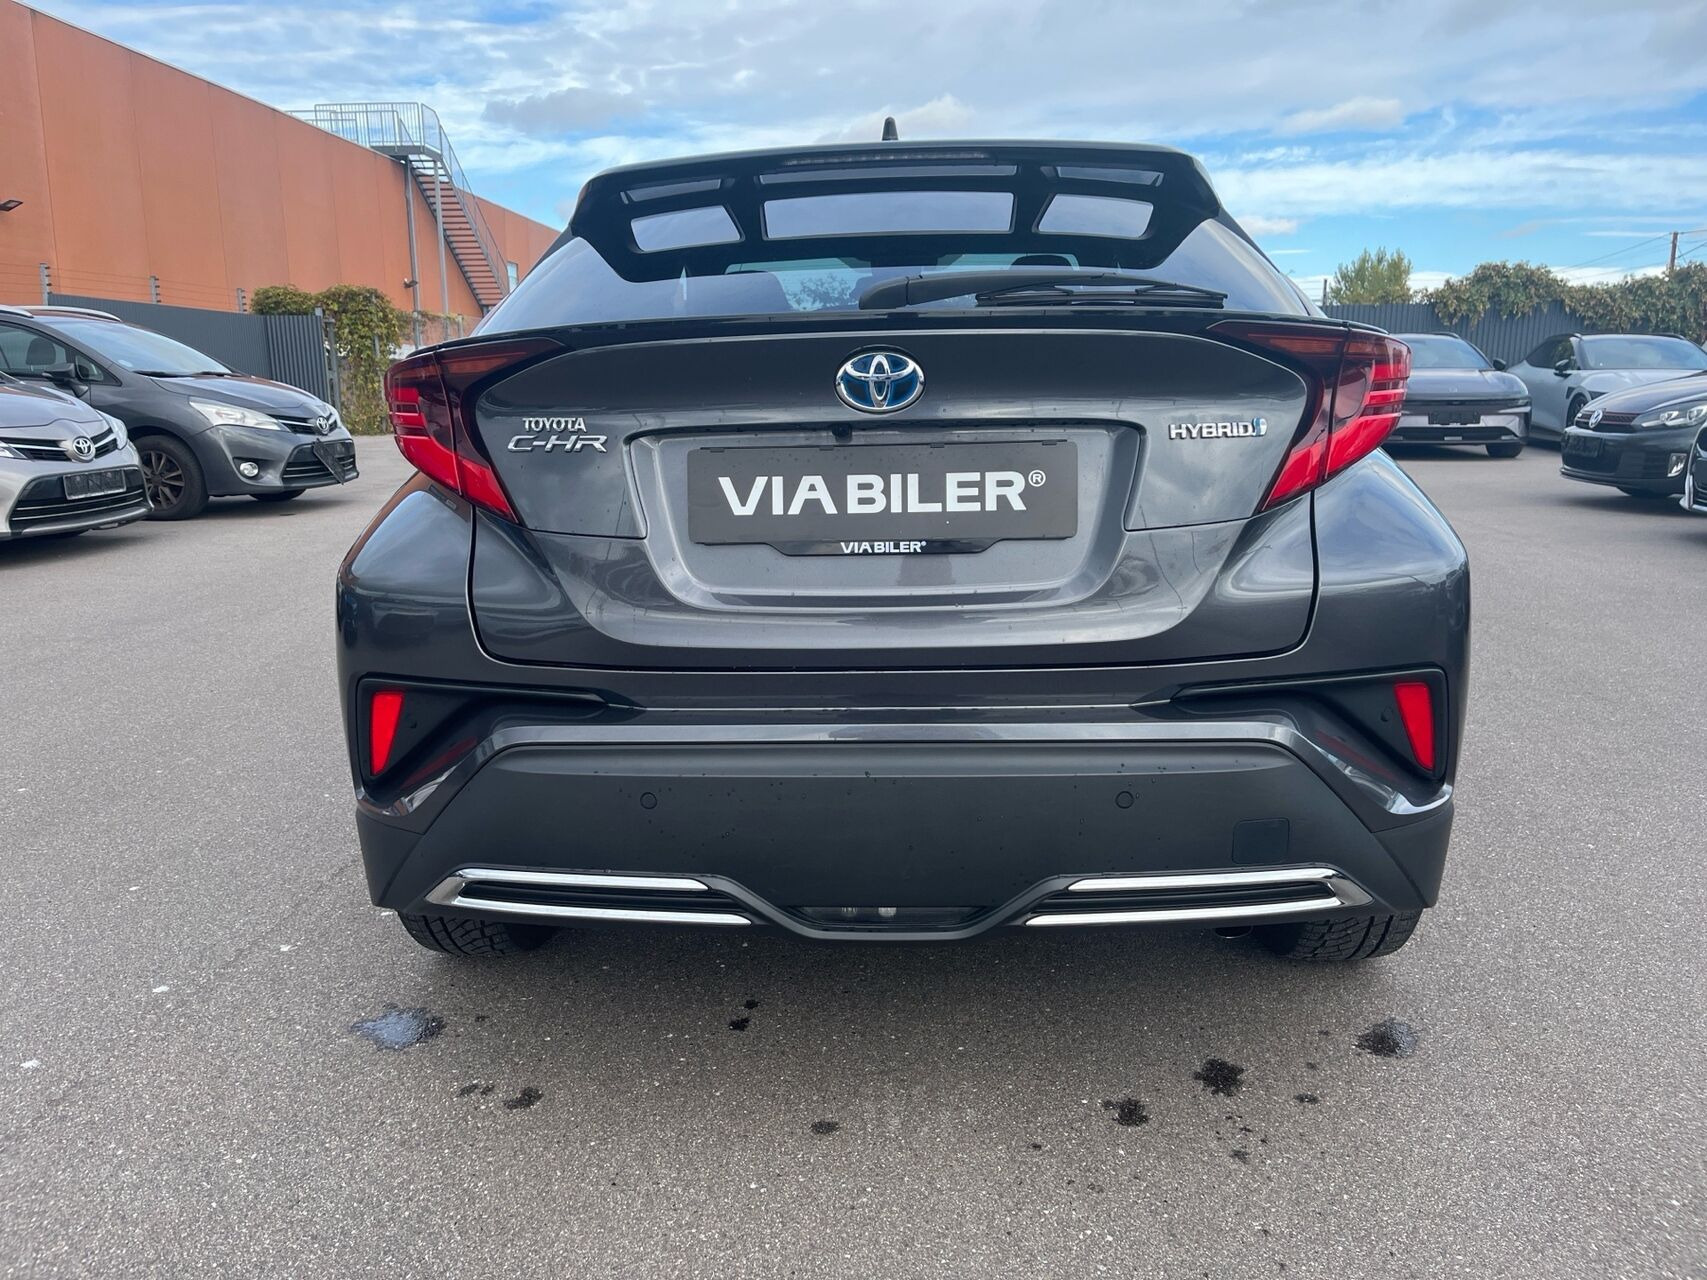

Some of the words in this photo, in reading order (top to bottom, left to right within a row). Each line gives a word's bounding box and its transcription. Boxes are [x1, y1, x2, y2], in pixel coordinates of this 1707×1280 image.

[522, 417, 587, 432] TOYOTA
[1169, 421, 1254, 440] HYBRID
[507, 434, 608, 453] C-HR
